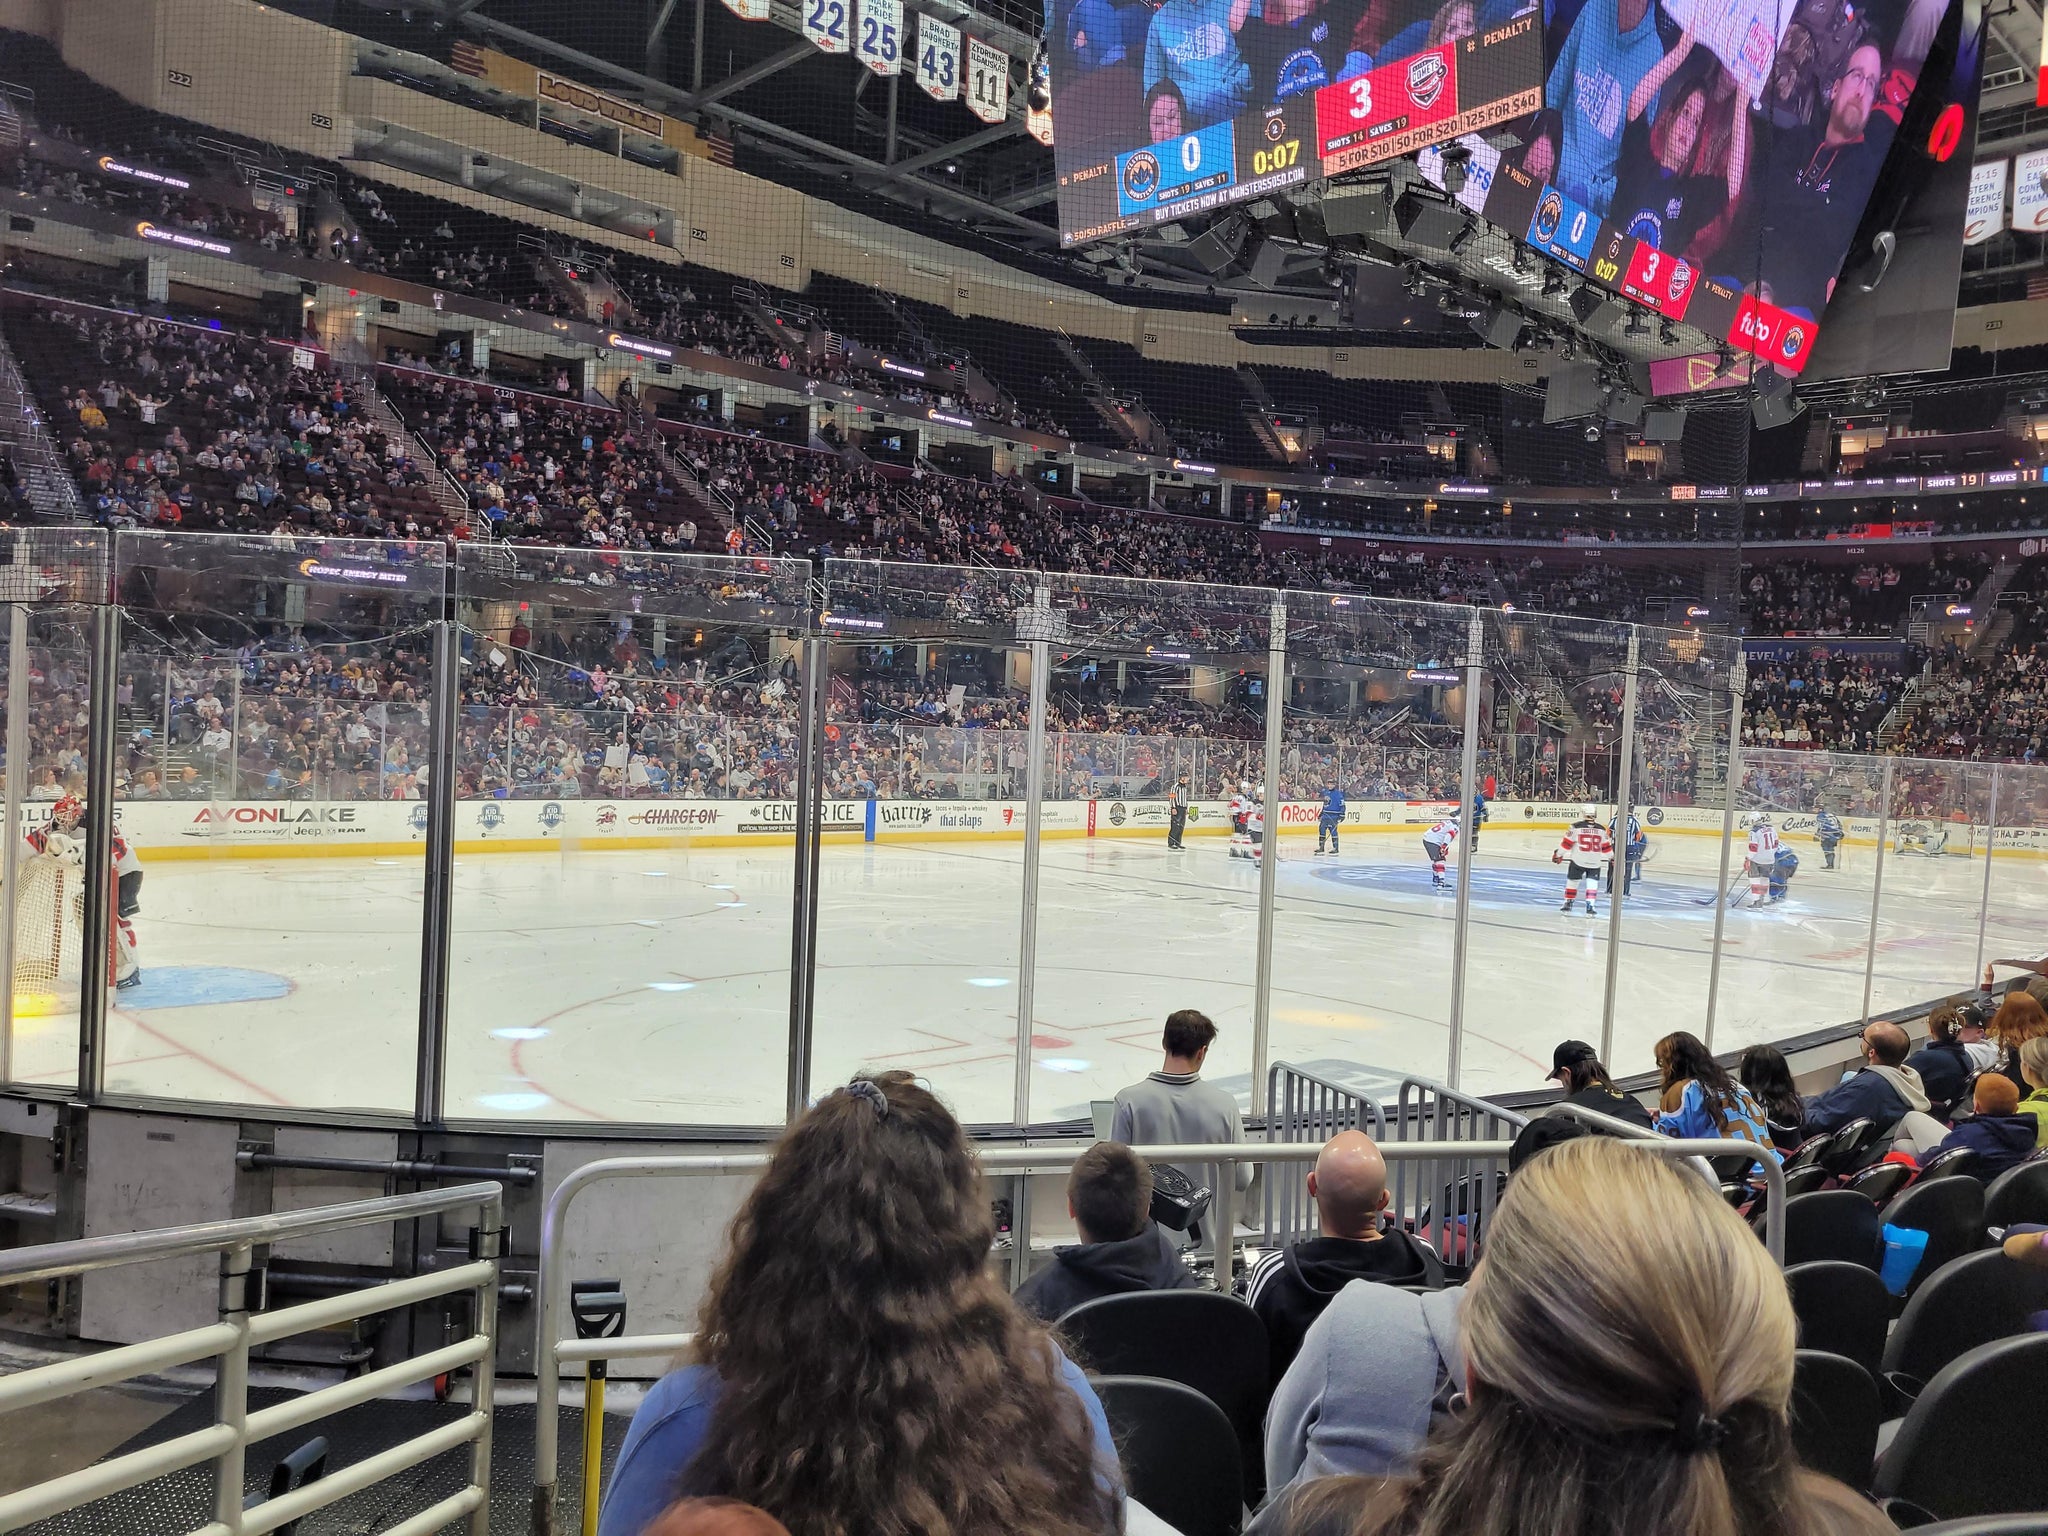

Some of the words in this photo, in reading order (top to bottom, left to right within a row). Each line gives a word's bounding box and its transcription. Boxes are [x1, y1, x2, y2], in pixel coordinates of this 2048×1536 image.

[808, 0, 844, 40] 22
[869, 5, 893, 22] PRICE
[929, 22, 950, 38] BRAD
[1484, 18, 1532, 47] PENALTY
[863, 17, 897, 61] 25
[971, 43, 1006, 64] ZYDRUNAS
[922, 45, 954, 86] 43
[169, 71, 192, 87] 222
[976, 69, 998, 107] 11
[1349, 78, 1372, 119] 3
[312, 114, 332, 129] 223
[1272, 125, 1278, 134] 2
[1340, 156, 1346, 167] 5
[1349, 148, 1369, 163] FOR
[1371, 142, 1389, 160] $10
[1398, 134, 1411, 150] 50
[1413, 130, 1433, 145] FOR
[1435, 121, 1458, 140] $20
[1466, 111, 1486, 128] 125
[1488, 103, 1510, 121] FOR
[1513, 93, 1536, 113] $40
[1327, 136, 1351, 150] SHOTS
[1369, 123, 1393, 137] SAVES
[1396, 118, 1407, 130] 19
[1127, 152, 1155, 170] CLEVELAND
[1181, 136, 1201, 172] 0
[1253, 139, 1300, 175] 0:07
[1073, 164, 1108, 183] PENALTY
[294, 181, 309, 190] 223
[1158, 188, 1179, 200] SHOTS
[1194, 178, 1215, 191] SAVES
[1155, 208, 1169, 221] BUY
[1171, 199, 1199, 217] TICKETS
[1201, 194, 1217, 208] NOW
[1218, 190, 1227, 203] AT
[1229, 168, 1305, 200] MONSTERS5050.COM
[1970, 191, 2002, 205] ERENCE
[1968, 203, 1999, 216] MPIONS
[692, 229, 708, 241] 224
[1074, 227, 1096, 241] 50/50
[1098, 219, 1126, 235] RAFFLE
[1570, 211, 1587, 243] 0
[1611, 245, 1617, 253] 2
[577, 265, 589, 274] 224
[781, 256, 795, 267] 225
[1595, 258, 1618, 282] 0:07
[1642, 253, 1660, 283] 3
[1712, 284, 1734, 300] PENALTY
[1740, 312, 1770, 341] fubo
[1144, 334, 1156, 342] 227
[501, 389, 515, 399] 120
[1927, 479, 1955, 487] SHOTS
[1962, 475, 1977, 486] 19
[1990, 474, 2017, 482] SAVES
[2022, 470, 2037, 481] 11
[1700, 487, 1728, 496] oswald
[309, 566, 342, 576] NOPEC
[343, 569, 378, 579] ENERGY
[378, 573, 408, 582] METER
[763, 804, 827, 821] CENR
[833, 804, 855, 821] ICE
[1133, 804, 1163, 817] FEBRUARY
[1292, 805, 1321, 822] Rock
[1348, 810, 1360, 822] nrg
[1379, 811, 1392, 822] nrg
[940, 812, 957, 827] that
[959, 813, 982, 829] slaps
[294, 826, 321, 837] Jeep
[1578, 834, 1601, 852] 58
